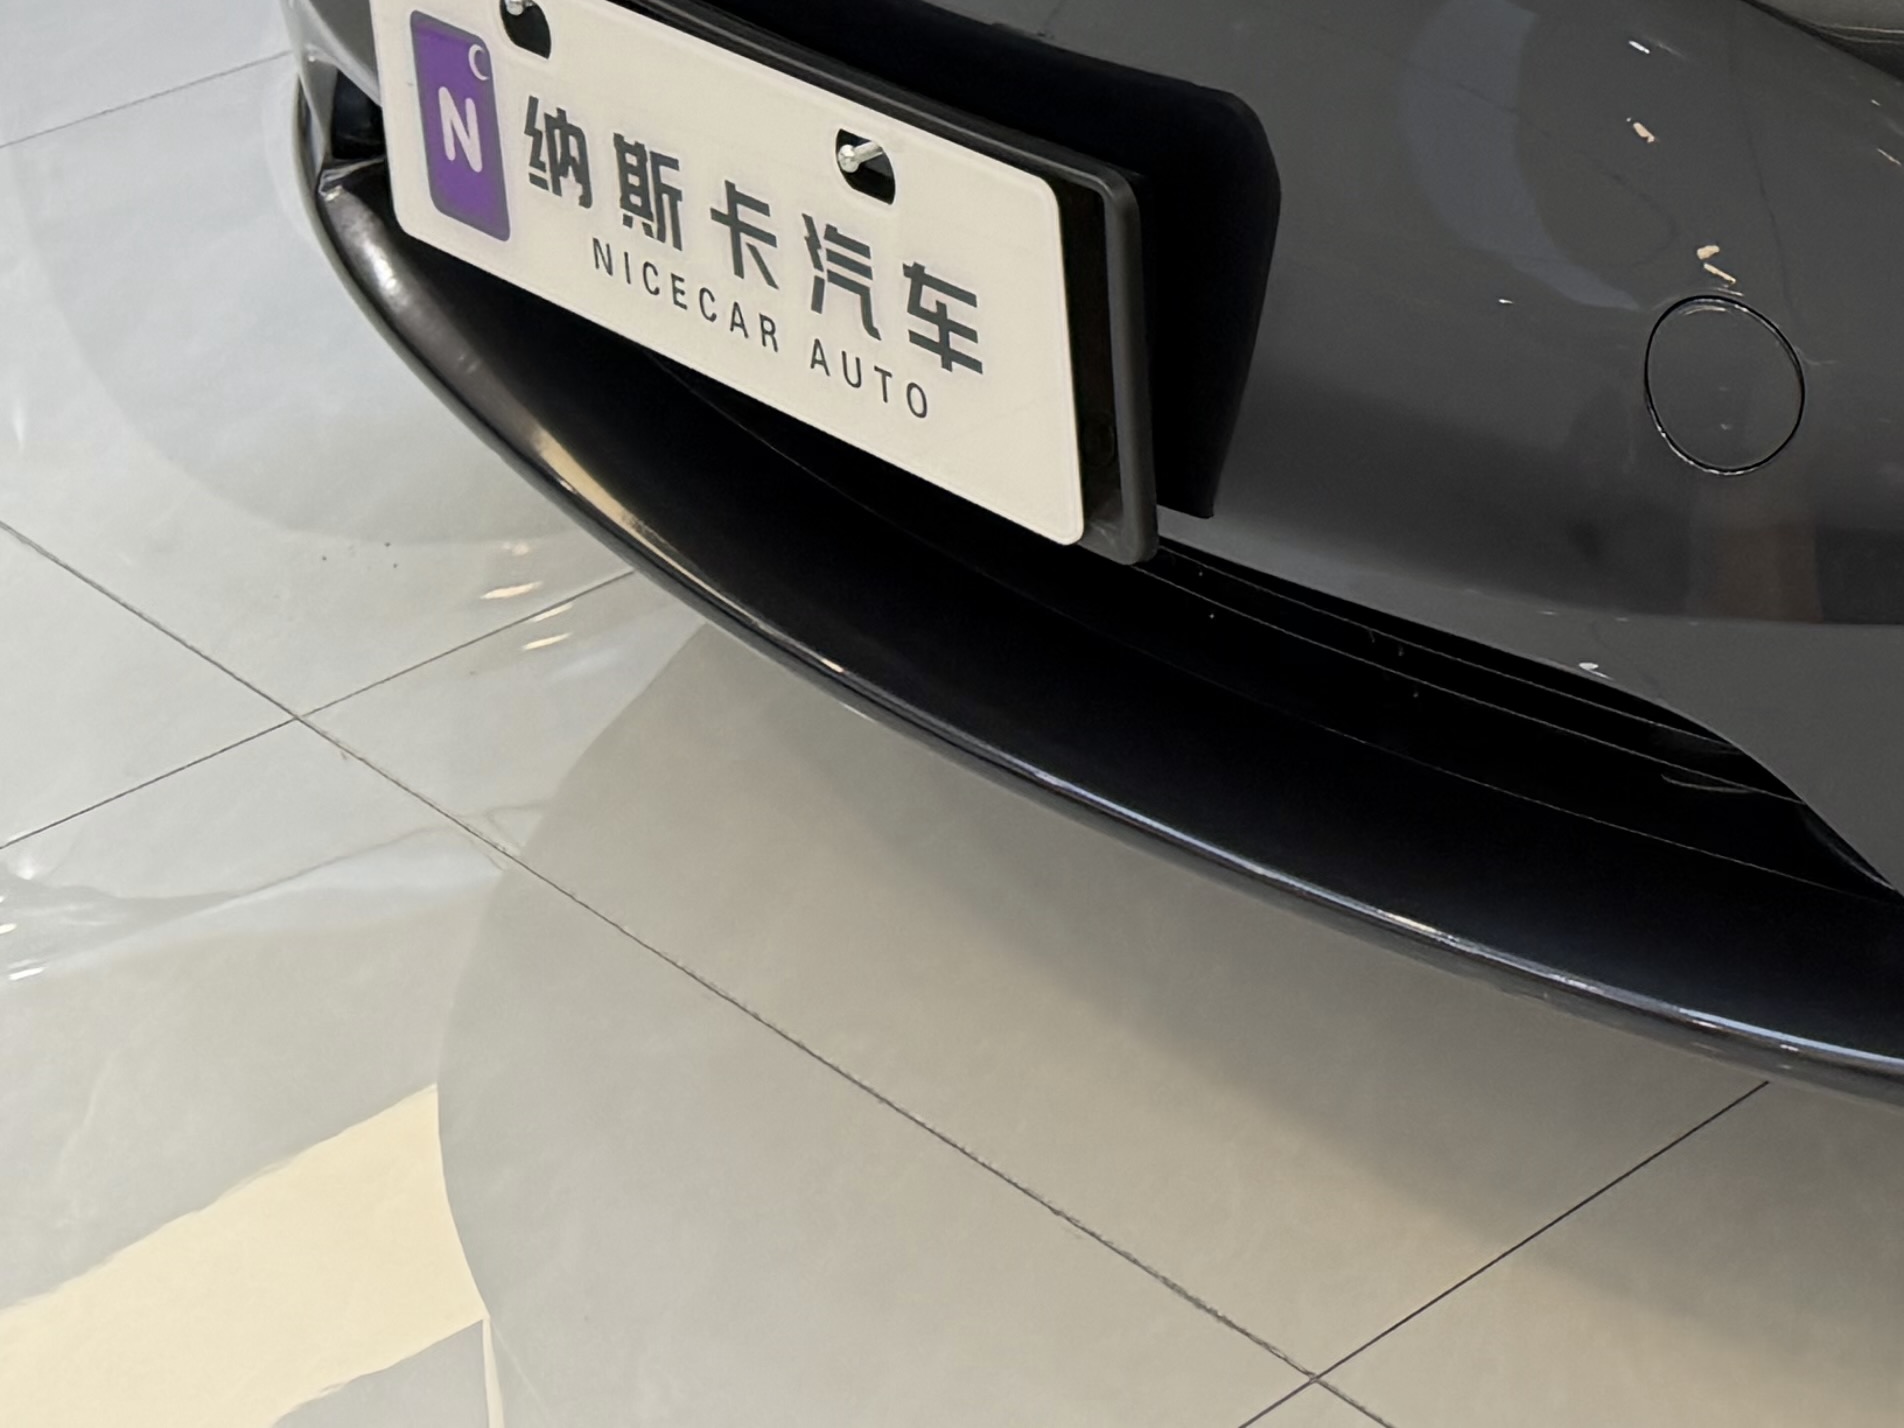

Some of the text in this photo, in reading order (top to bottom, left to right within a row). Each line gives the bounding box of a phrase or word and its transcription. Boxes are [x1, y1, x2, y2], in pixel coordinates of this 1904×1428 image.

[523, 95, 985, 376] 纳斯卡汽车
[593, 236, 930, 419] NICECAR AUTO
